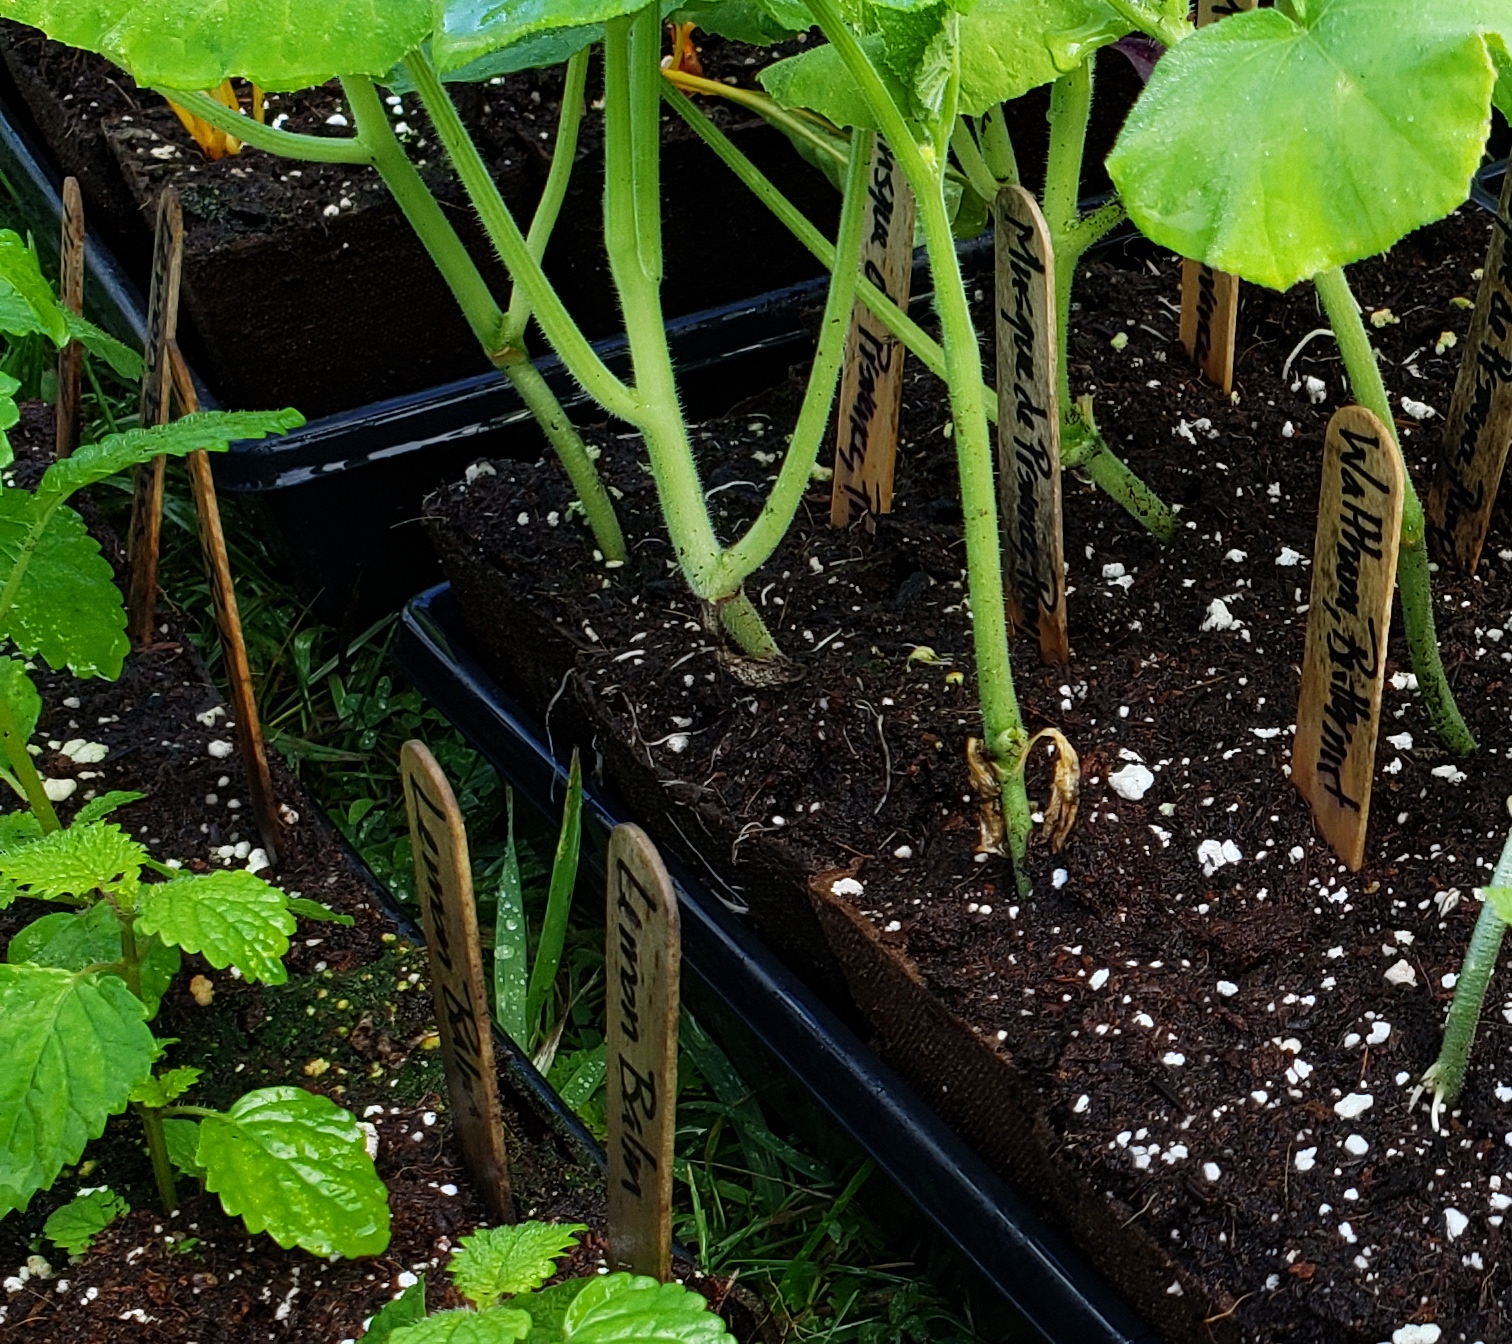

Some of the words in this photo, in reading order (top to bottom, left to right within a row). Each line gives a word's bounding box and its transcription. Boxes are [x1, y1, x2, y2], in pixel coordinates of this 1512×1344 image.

[1001, 212, 1046, 388] Musque
[1013, 381, 1048, 432] de
[1322, 424, 1390, 625] Waltham,
[615, 857, 658, 1044] Lemon
[618, 1053, 658, 1199] Balm
